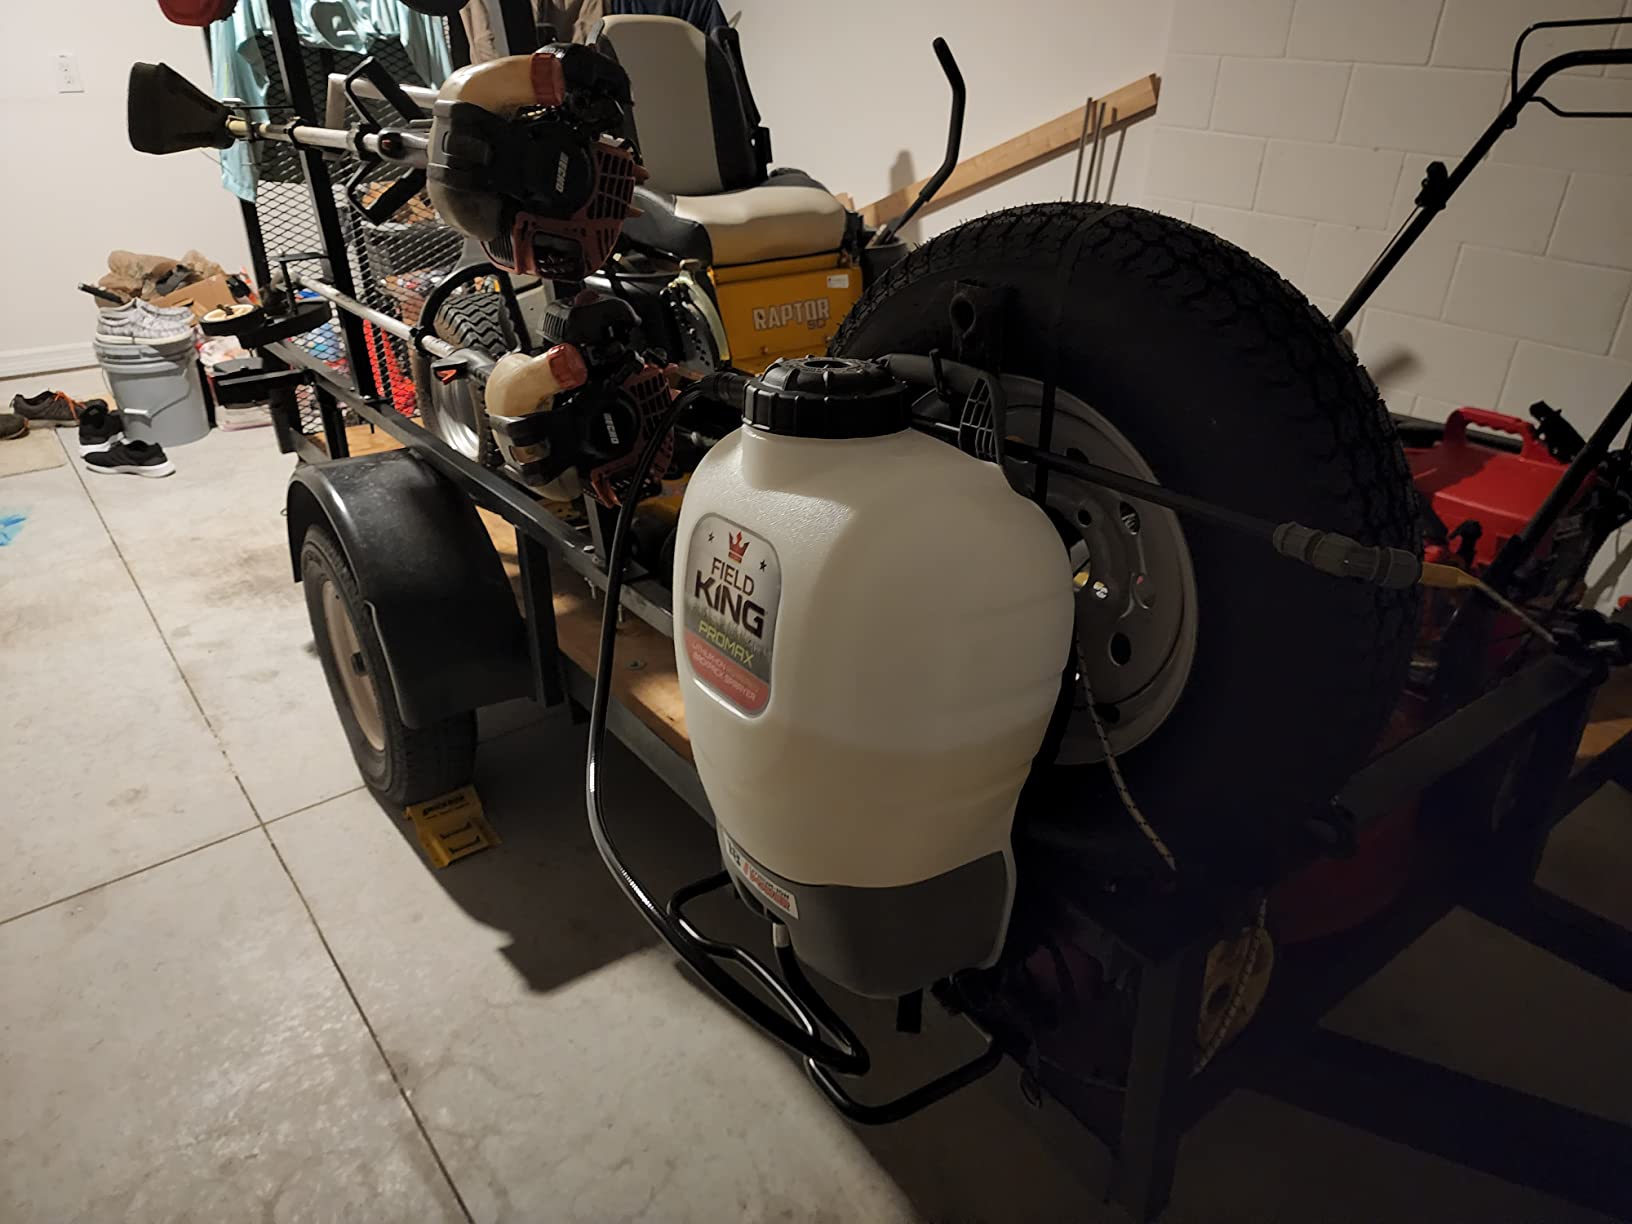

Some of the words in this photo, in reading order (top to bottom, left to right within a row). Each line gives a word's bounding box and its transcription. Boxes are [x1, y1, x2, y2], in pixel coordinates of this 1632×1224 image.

[555, 153, 569, 193] ECHO
[752, 298, 830, 330] RAPTOR
[603, 412, 620, 445] ECHO
[711, 556, 755, 597] FIELD
[694, 570, 766, 640] KING
[698, 619, 753, 668] PROMAX
